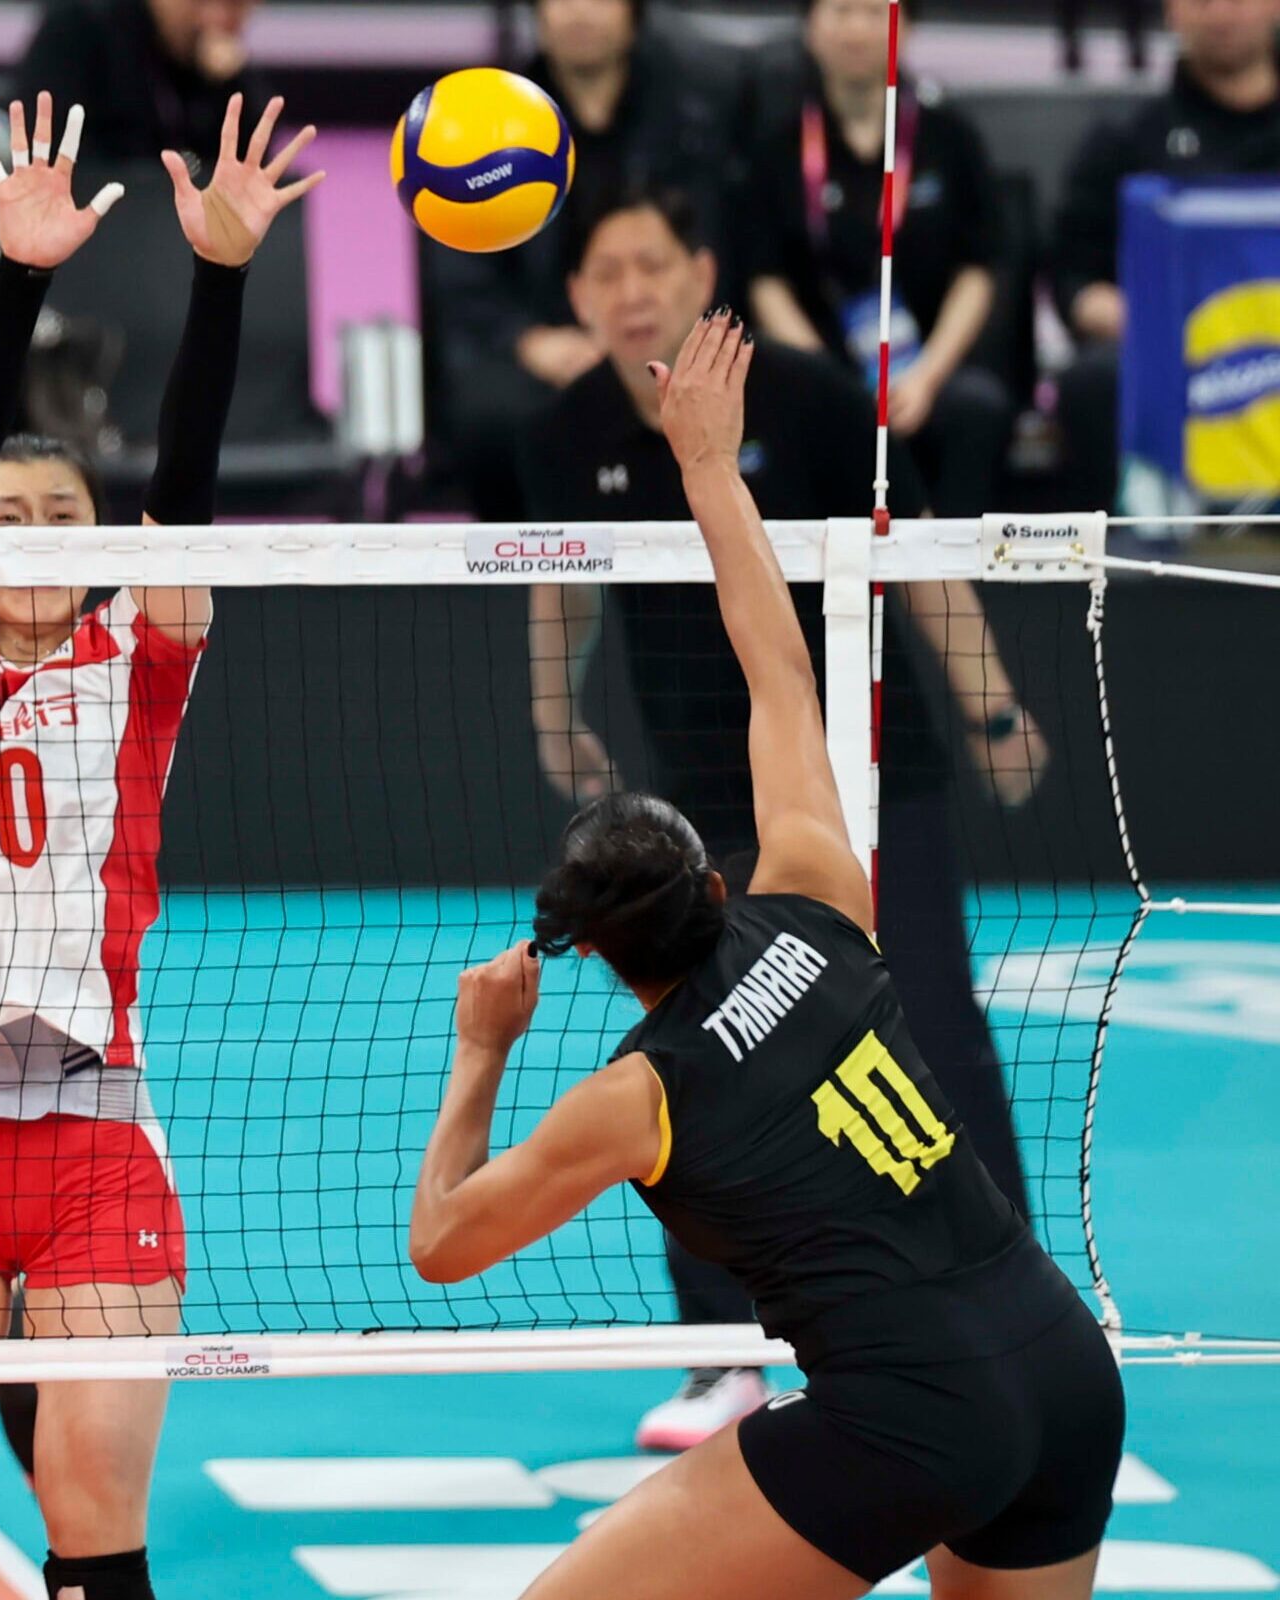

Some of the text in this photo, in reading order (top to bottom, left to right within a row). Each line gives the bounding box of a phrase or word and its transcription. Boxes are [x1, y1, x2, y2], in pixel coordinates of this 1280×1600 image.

[465, 162, 513, 191] V200W
[518, 528, 564, 538] Volleyball
[1020, 525, 1079, 539] Senoh
[494, 541, 586, 558] CLUB
[466, 558, 613, 574] WORLD CHAMPS
[701, 931, 829, 1063] TAINARA
[810, 1028, 956, 1196] 10
[184, 1353, 249, 1365] CLUB
[166, 1365, 270, 1376] WORLD CHAMPS
